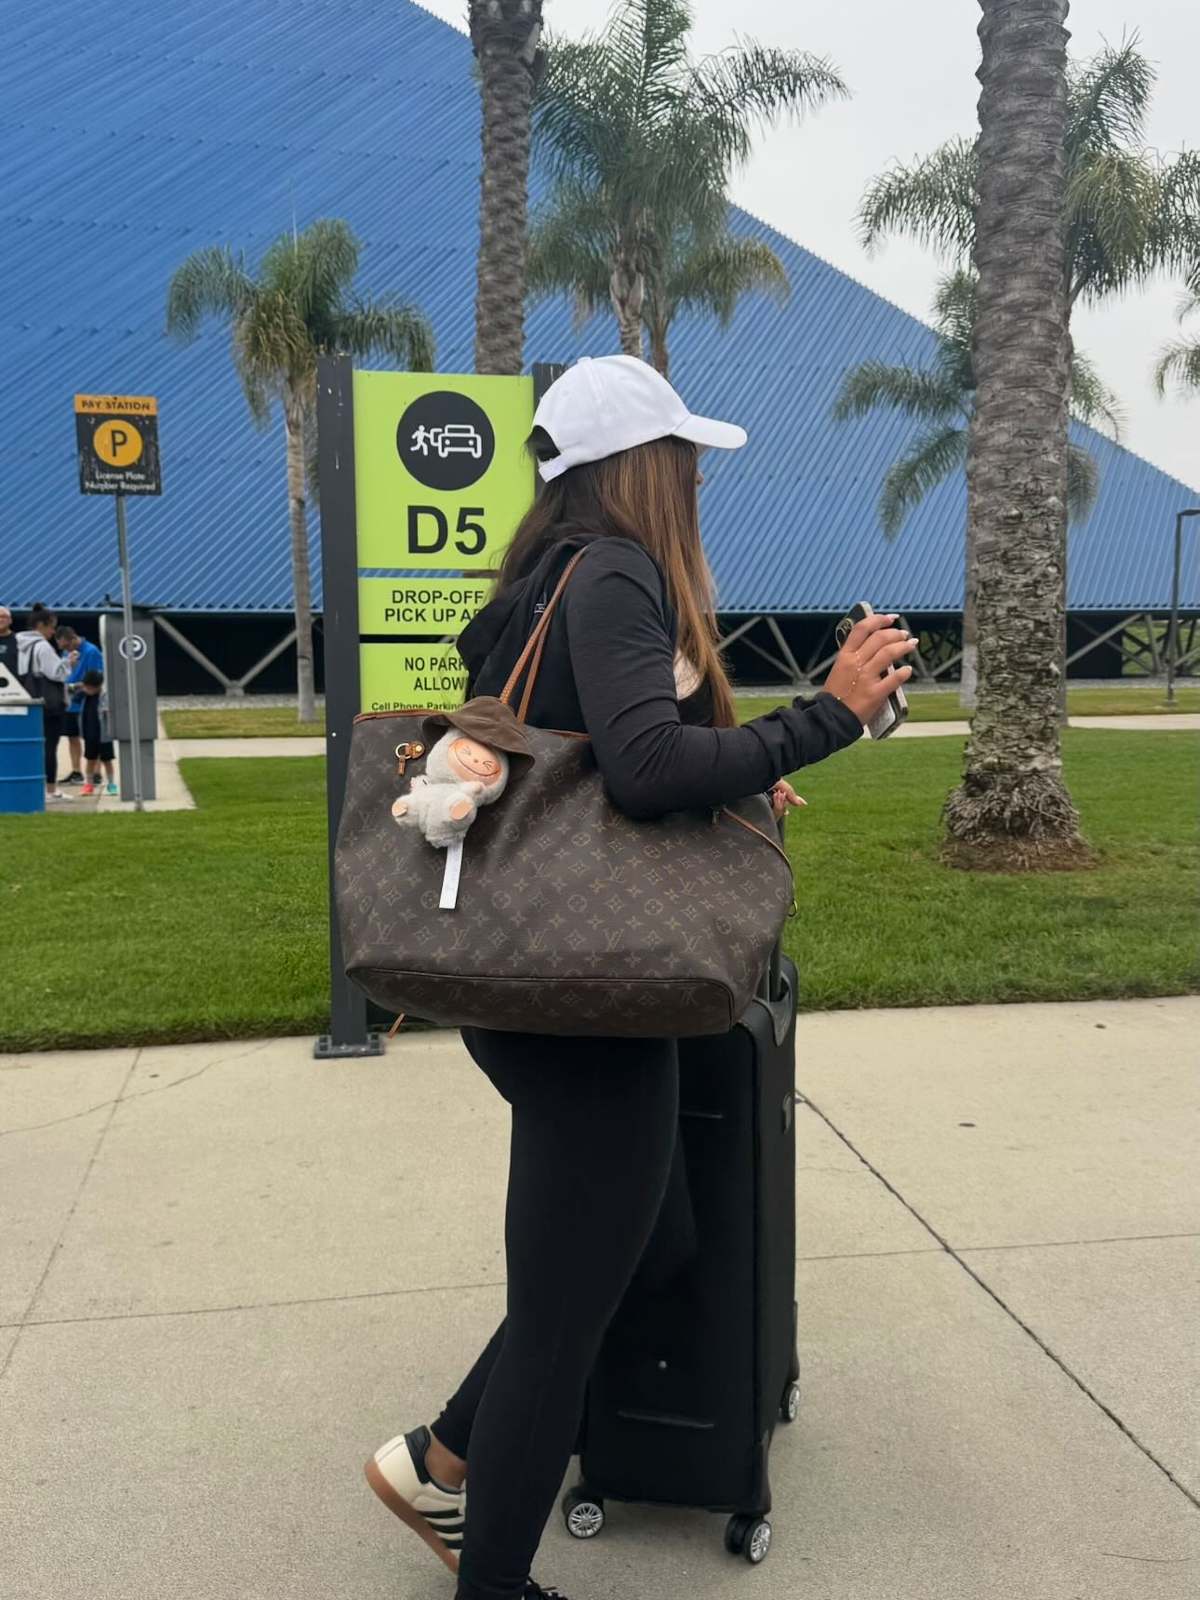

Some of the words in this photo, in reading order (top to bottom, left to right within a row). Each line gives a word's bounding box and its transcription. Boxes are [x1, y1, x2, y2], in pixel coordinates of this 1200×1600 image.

[81, 400, 102, 408] PAY
[105, 401, 150, 410] STATION
[111, 430, 128, 458] P
[407, 505, 487, 555] D5
[392, 590, 484, 604] DROP-OFF
[385, 608, 427, 622] PICK
[432, 609, 456, 622] UP
[404, 657, 425, 671] NO
[371, 702, 391, 711] Cell
[393, 702, 424, 710] Phone
